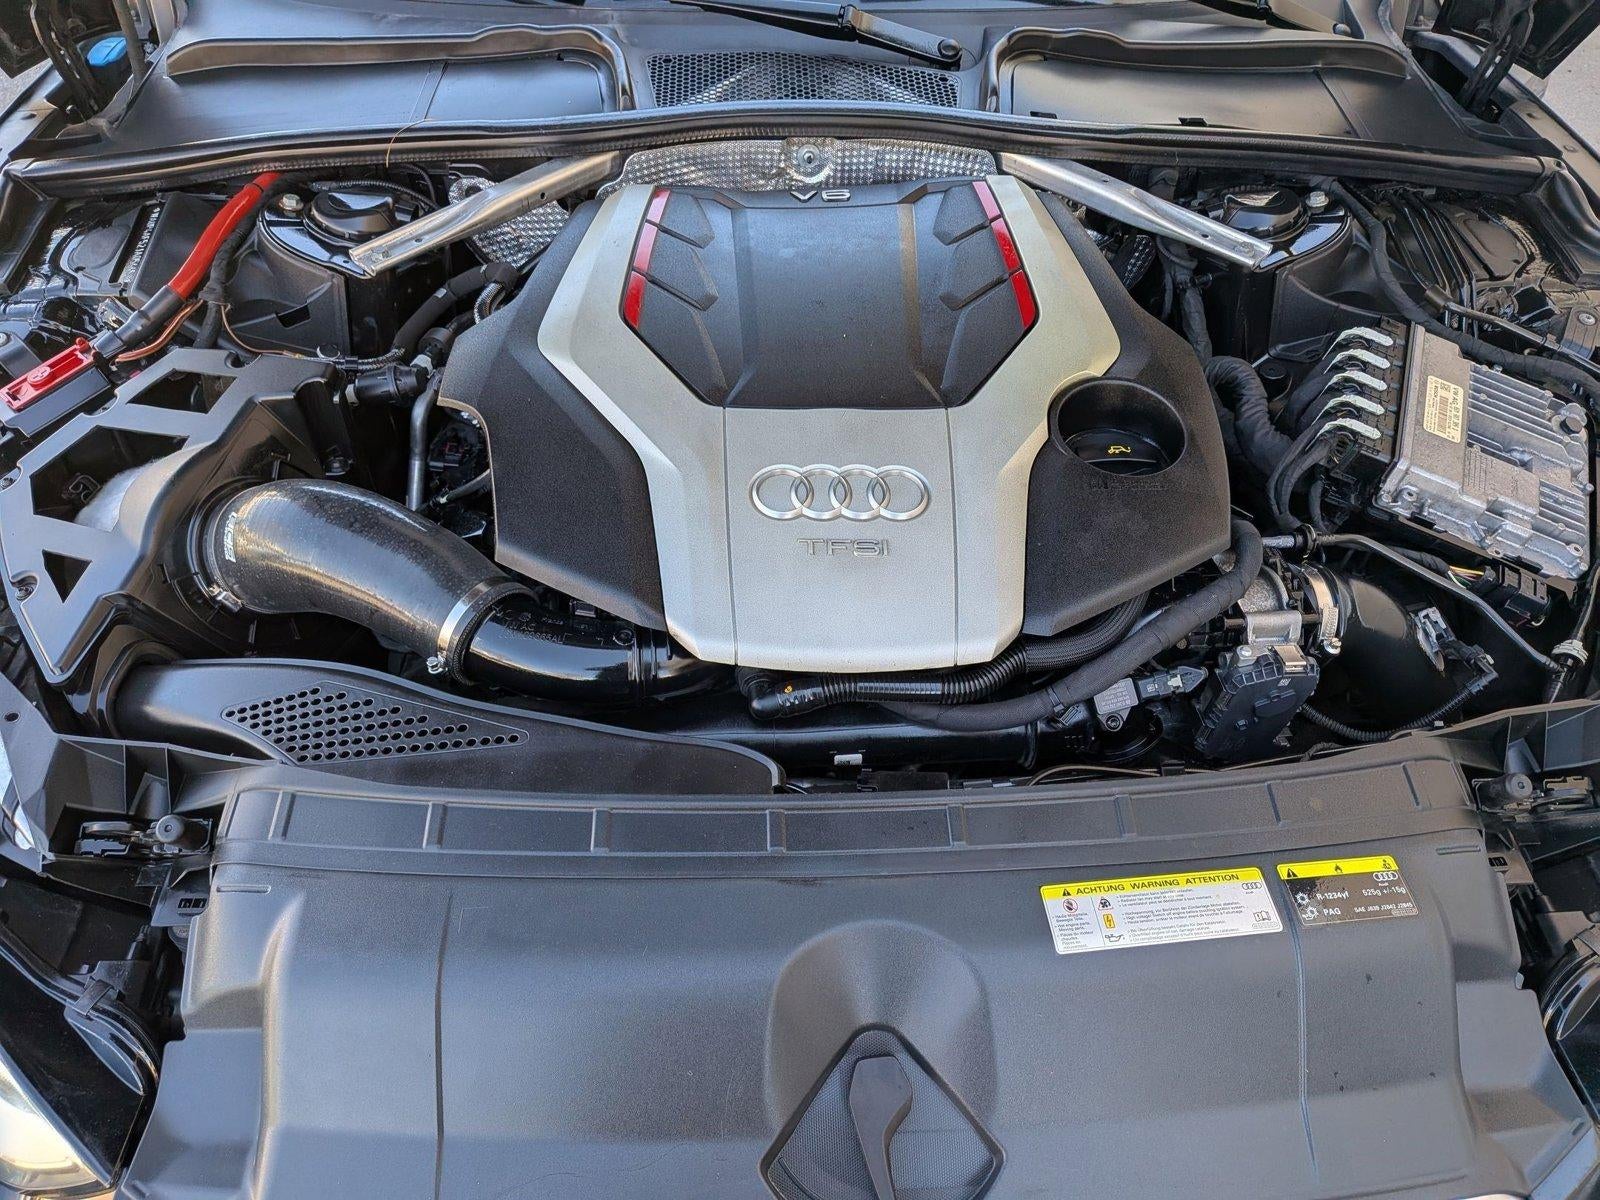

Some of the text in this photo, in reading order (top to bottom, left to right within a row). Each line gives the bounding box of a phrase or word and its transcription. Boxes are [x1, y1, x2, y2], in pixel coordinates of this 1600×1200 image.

[790, 189, 851, 203] V6
[797, 538, 890, 558] TFSI
[1076, 884, 1125, 895] ACHTUNG
[1130, 879, 1180, 890] WARNING
[1185, 874, 1239, 885] ATTENTION
[1316, 886, 1406, 901] R-1234yf 525g +/-15g
[1323, 907, 1341, 916] PAG
